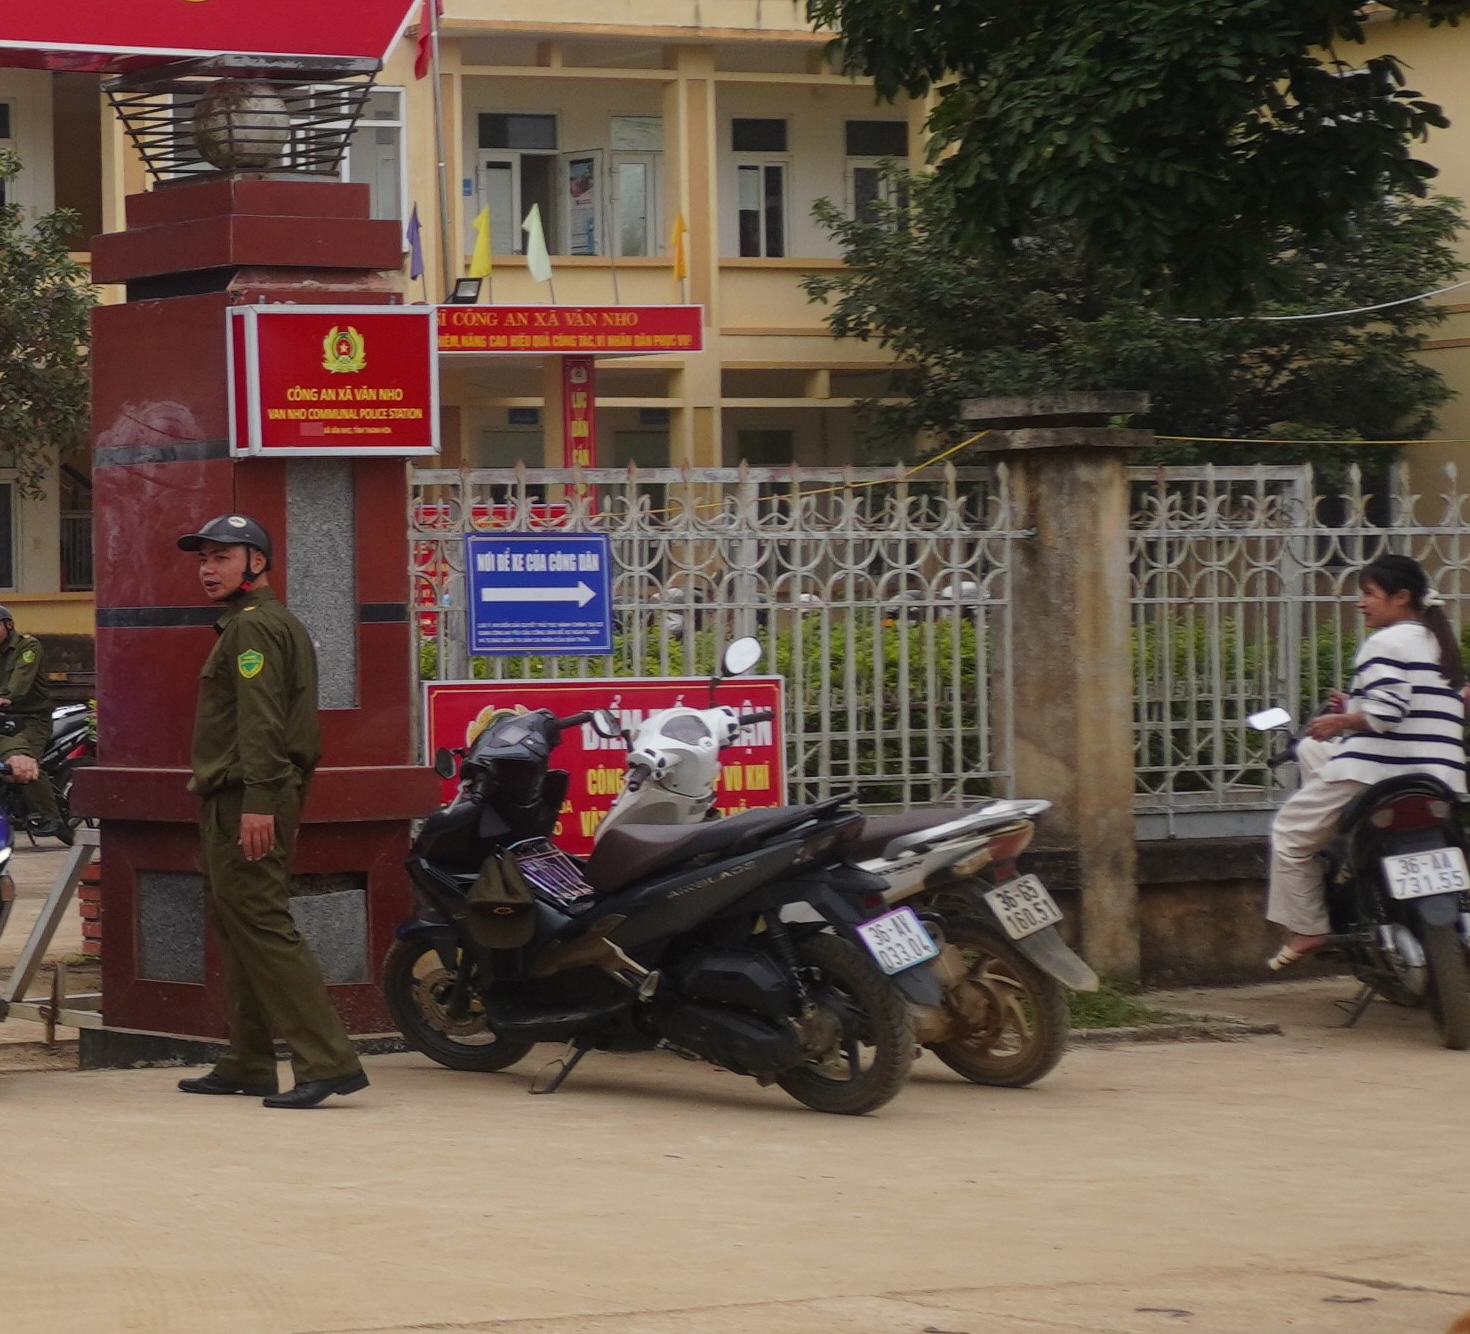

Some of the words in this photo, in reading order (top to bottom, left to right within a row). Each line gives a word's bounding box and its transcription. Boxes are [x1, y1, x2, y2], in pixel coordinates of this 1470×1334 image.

[452, 308, 499, 326] CÔNG
[503, 312, 529, 327] AN
[533, 309, 560, 327] XÃ
[564, 308, 598, 327] VĂN
[601, 312, 639, 327] NHO
[287, 385, 319, 401] CÔNG
[319, 388, 337, 401] AN
[337, 385, 353, 401] XÃ
[354, 385, 377, 401] VĂN
[378, 388, 404, 401] NHO
[287, 408, 307, 420] NHO
[307, 408, 359, 419] COMMUNAL
[359, 408, 388, 419] POLICE
[388, 408, 423, 419] STATION
[477, 551, 496, 572] NƠI
[496, 547, 511, 572] ĐỂ
[511, 553, 524, 572] XE
[525, 549, 548, 572] CỦA
[548, 550, 577, 572] CÔNG
[577, 550, 600, 572] DÂN
[722, 761, 743, 792] VŨ
[745, 760, 771, 790] KHÍ
[1395, 870, 1465, 896] 731.55
[1006, 898, 1058, 933] 160.51
[878, 933, 932, 969] 033.04
